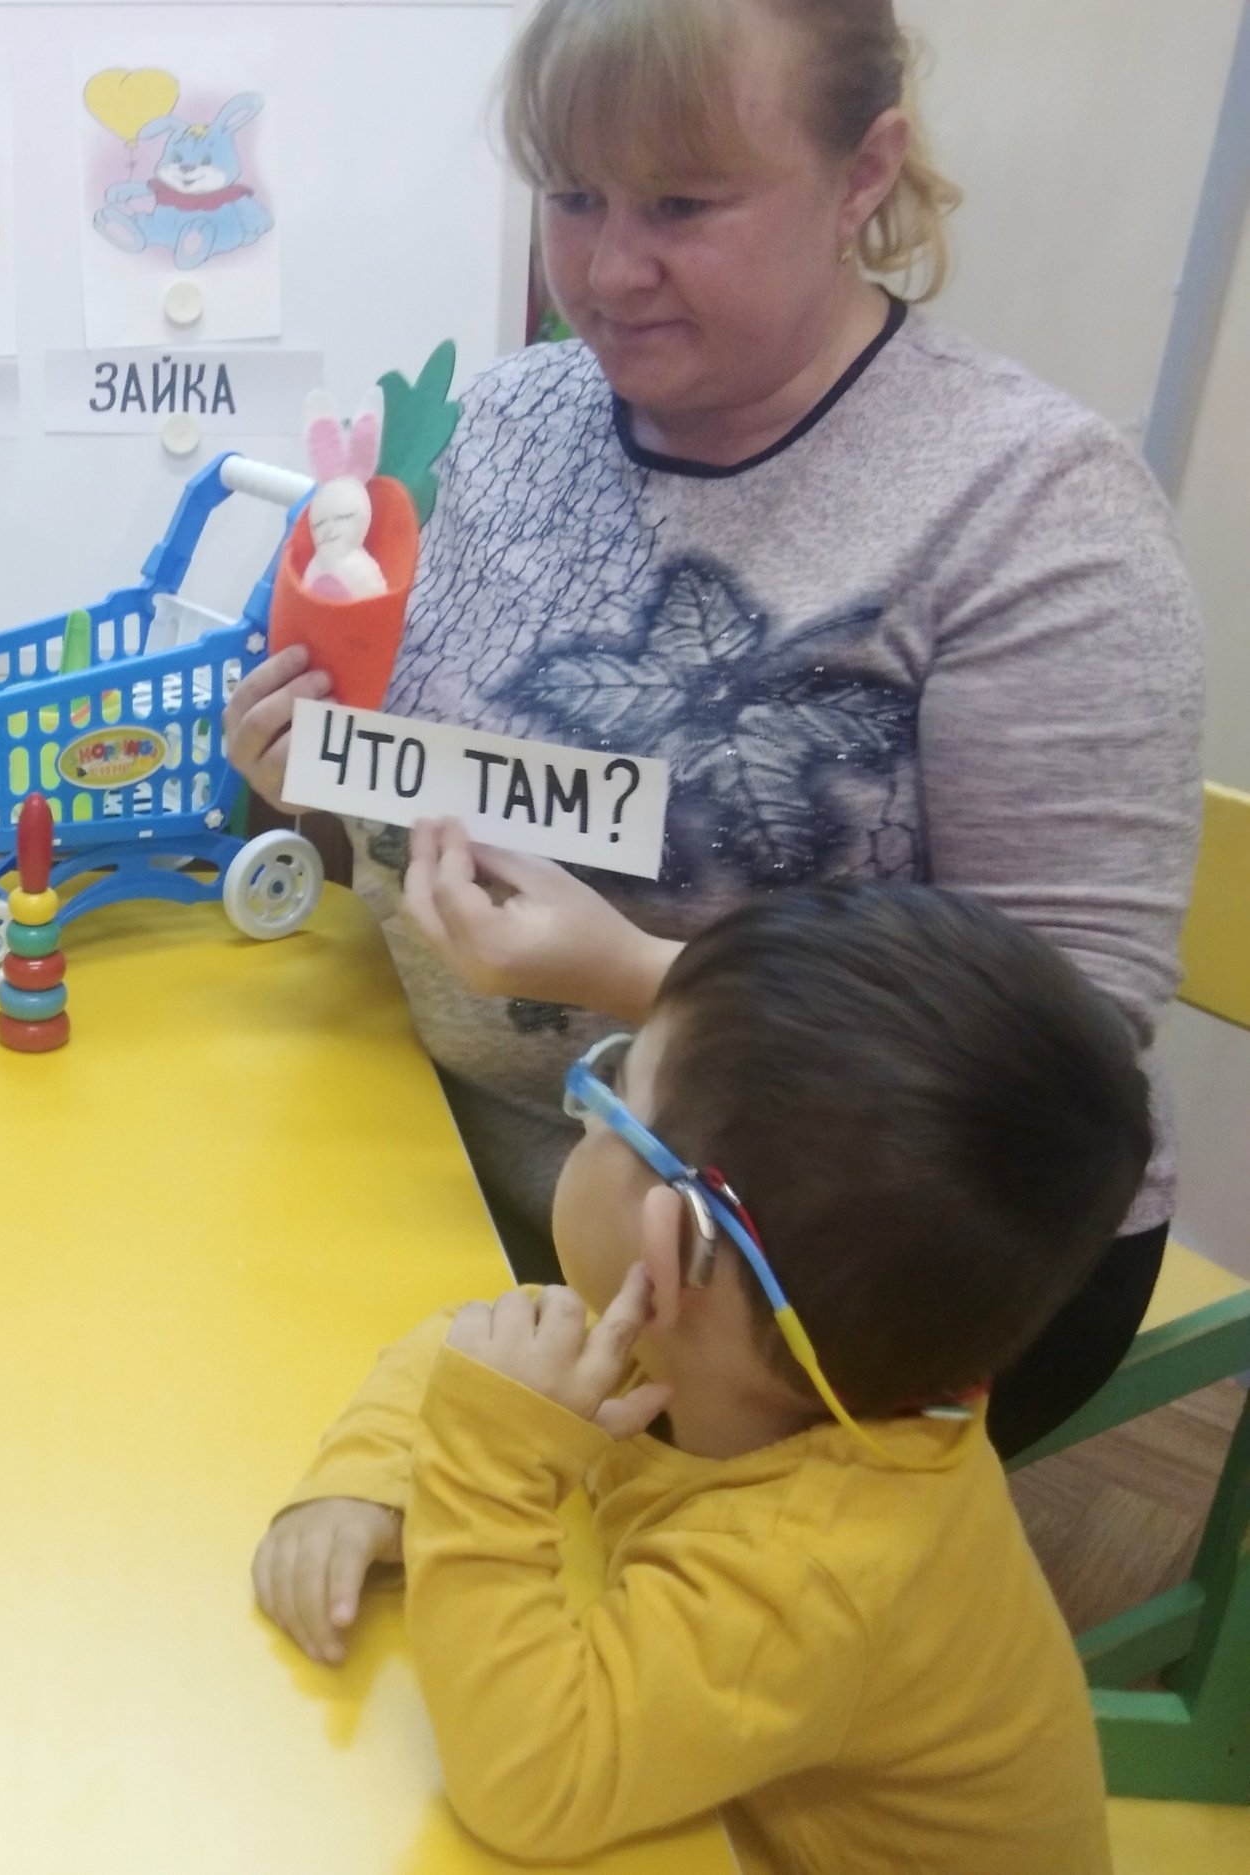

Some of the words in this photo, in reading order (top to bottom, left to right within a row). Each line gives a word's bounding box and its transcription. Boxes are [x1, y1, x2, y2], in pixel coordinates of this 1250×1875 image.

[89, 354, 236, 415] ЗАЙКА
[320, 709, 426, 798] ЧТО
[463, 748, 640, 843] ТАМ?
